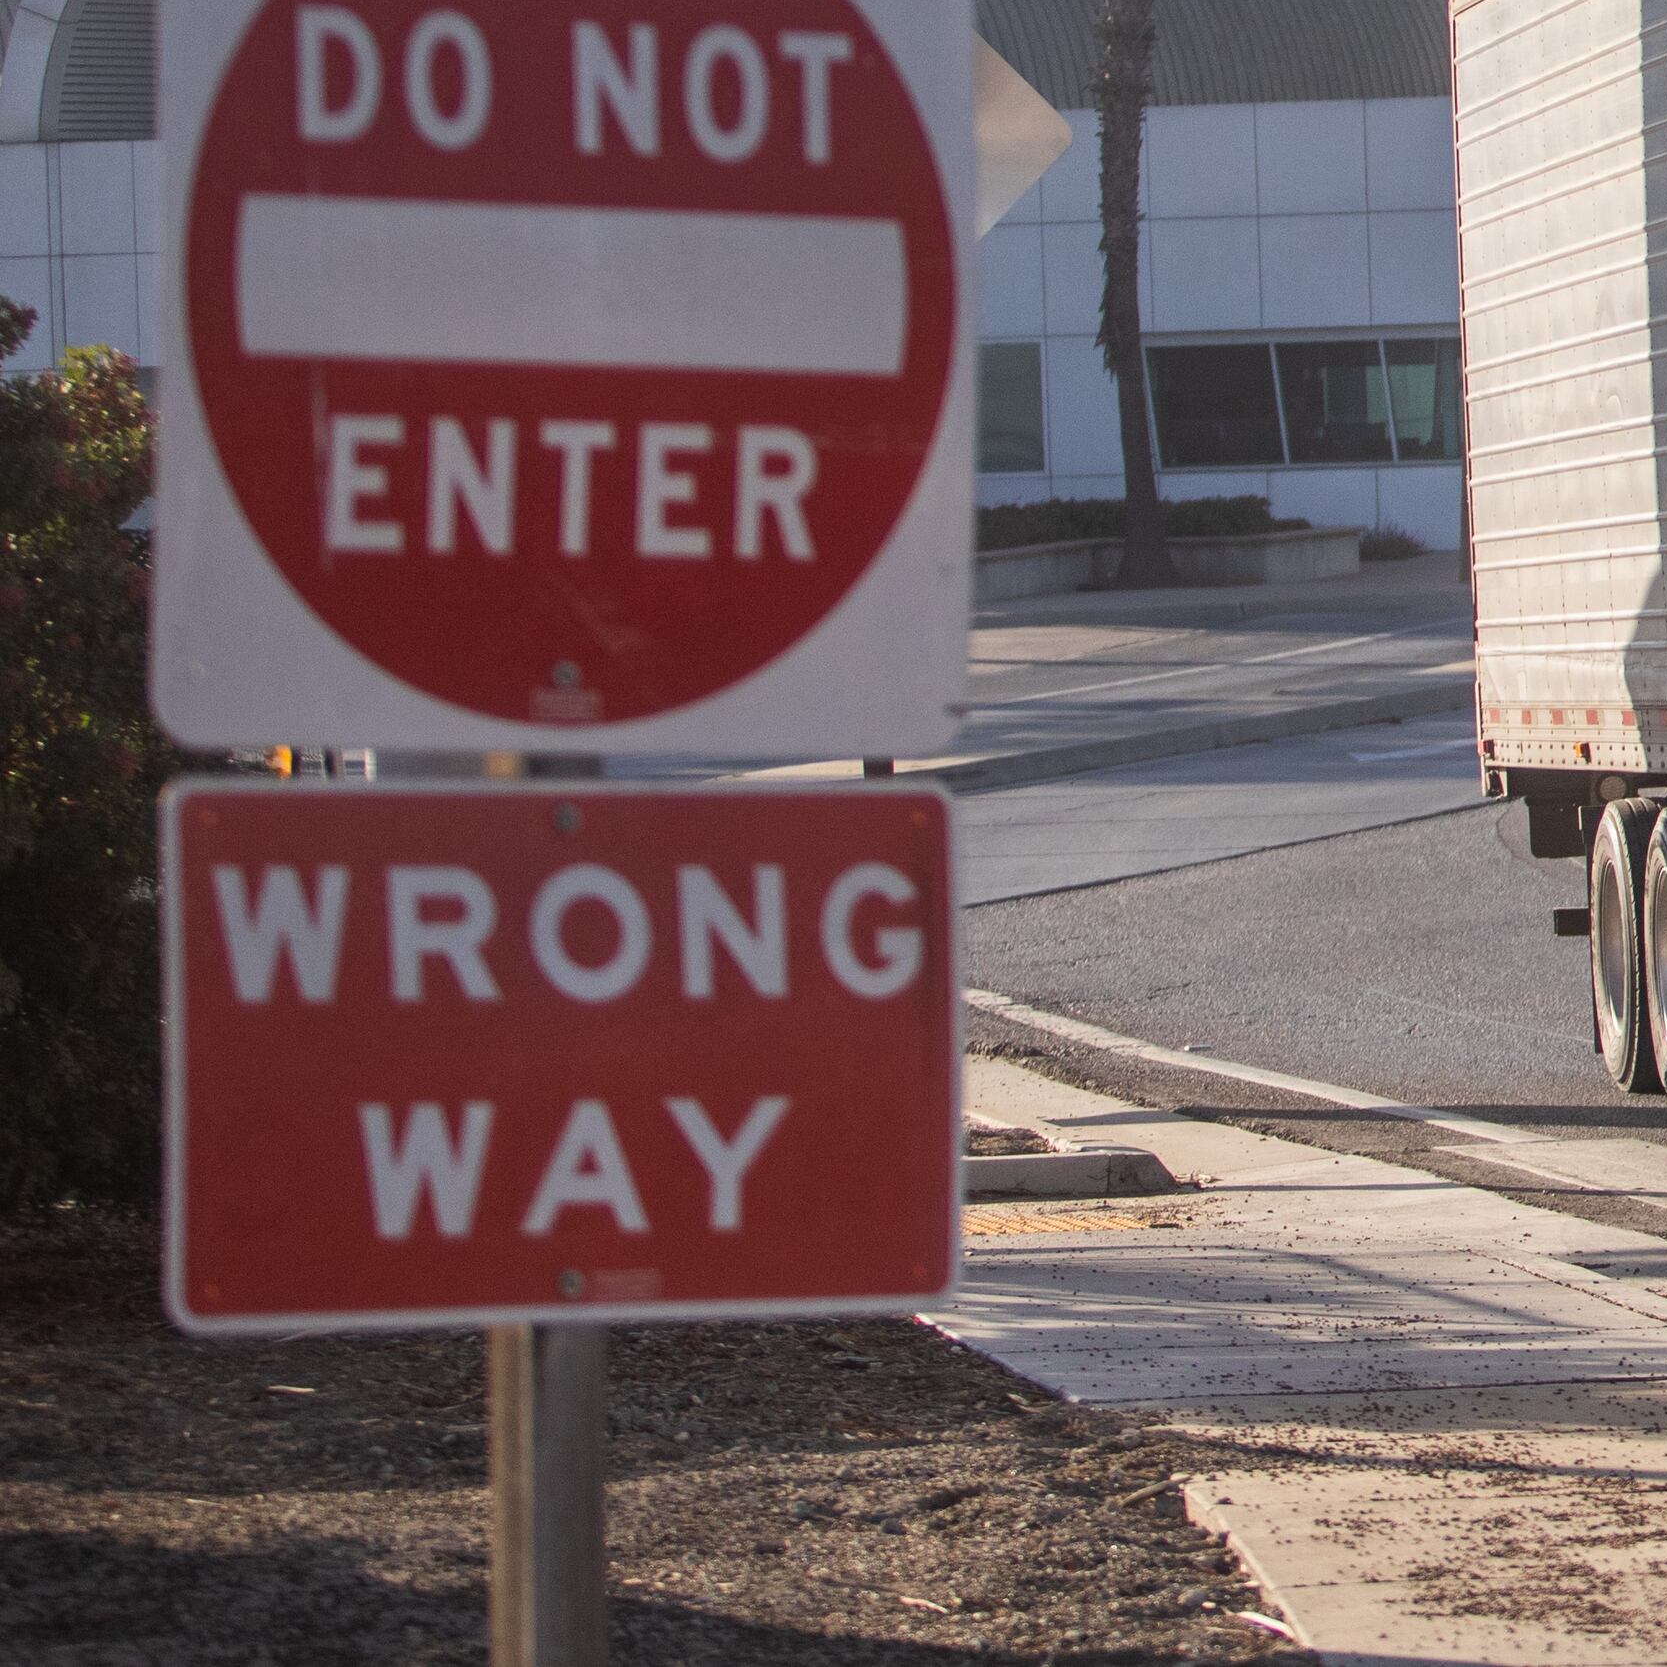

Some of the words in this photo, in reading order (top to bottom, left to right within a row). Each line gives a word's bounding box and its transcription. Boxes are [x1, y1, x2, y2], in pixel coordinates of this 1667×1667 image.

[295, 5, 493, 149] DO
[571, 20, 854, 164] NOT
[325, 414, 816, 561] ENTER
[213, 863, 922, 1004] WRONG
[359, 1097, 790, 1239] WAY
